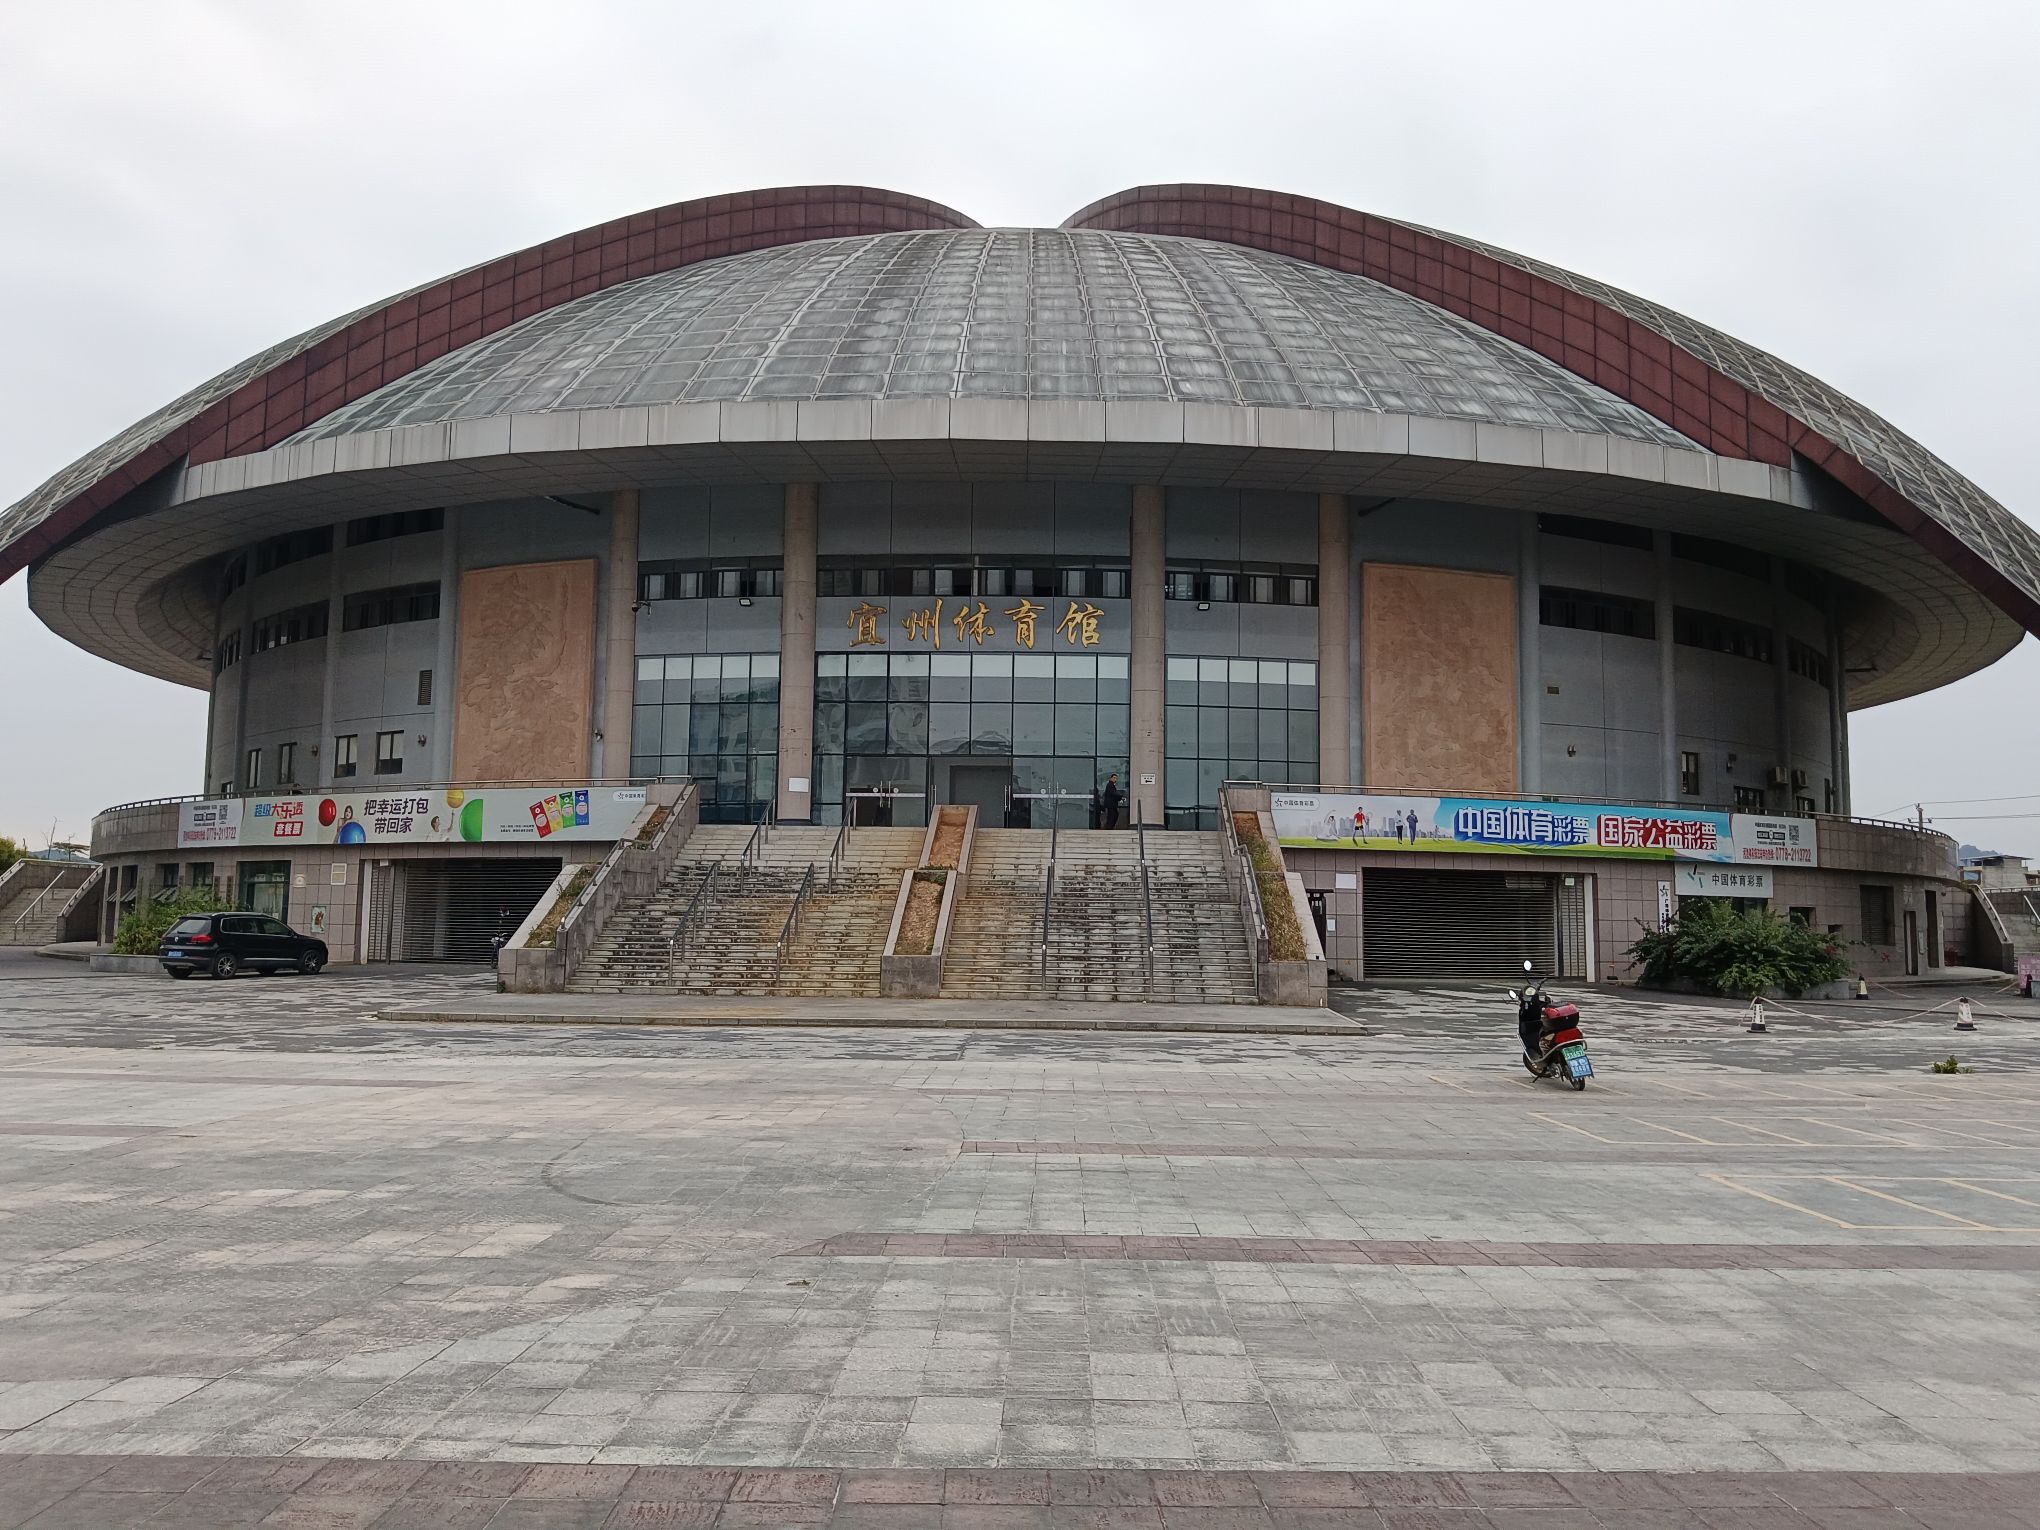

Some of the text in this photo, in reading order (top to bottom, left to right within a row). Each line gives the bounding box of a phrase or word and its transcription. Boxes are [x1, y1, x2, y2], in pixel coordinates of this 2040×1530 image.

[847, 598, 1105, 649] 宜州体育馆
[254, 801, 304, 819] 超级大乐透
[363, 798, 429, 817] 把幸运打包
[374, 817, 414, 835] 带回家
[1458, 806, 1718, 851] 中国体育彩票 国家公益彩票
[1711, 873, 1764, 888] 中国体育彩票
